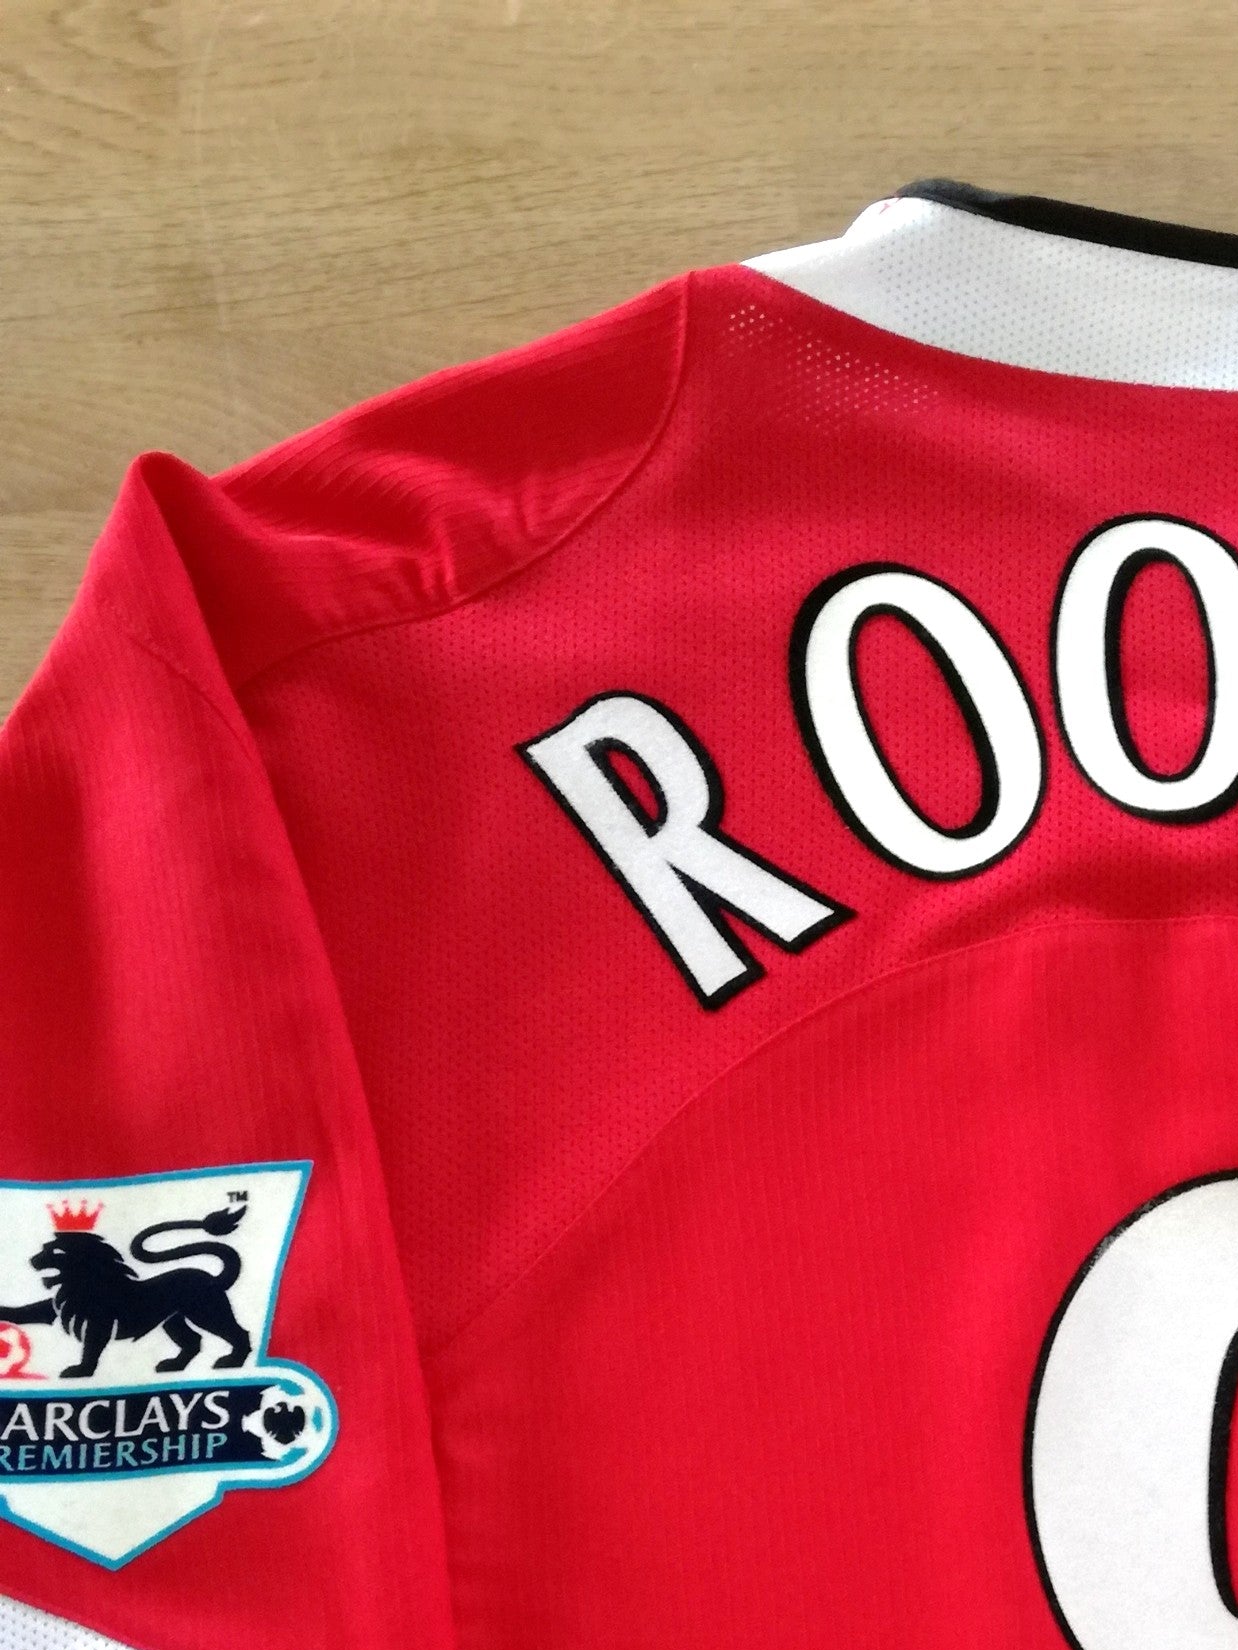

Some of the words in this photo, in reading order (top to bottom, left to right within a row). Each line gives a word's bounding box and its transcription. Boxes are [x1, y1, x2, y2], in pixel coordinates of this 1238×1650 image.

[227, 1191, 248, 1203] TM
[0, 1390, 230, 1441] ARCLAYS
[0, 1432, 228, 1471] REMIERSHIP
